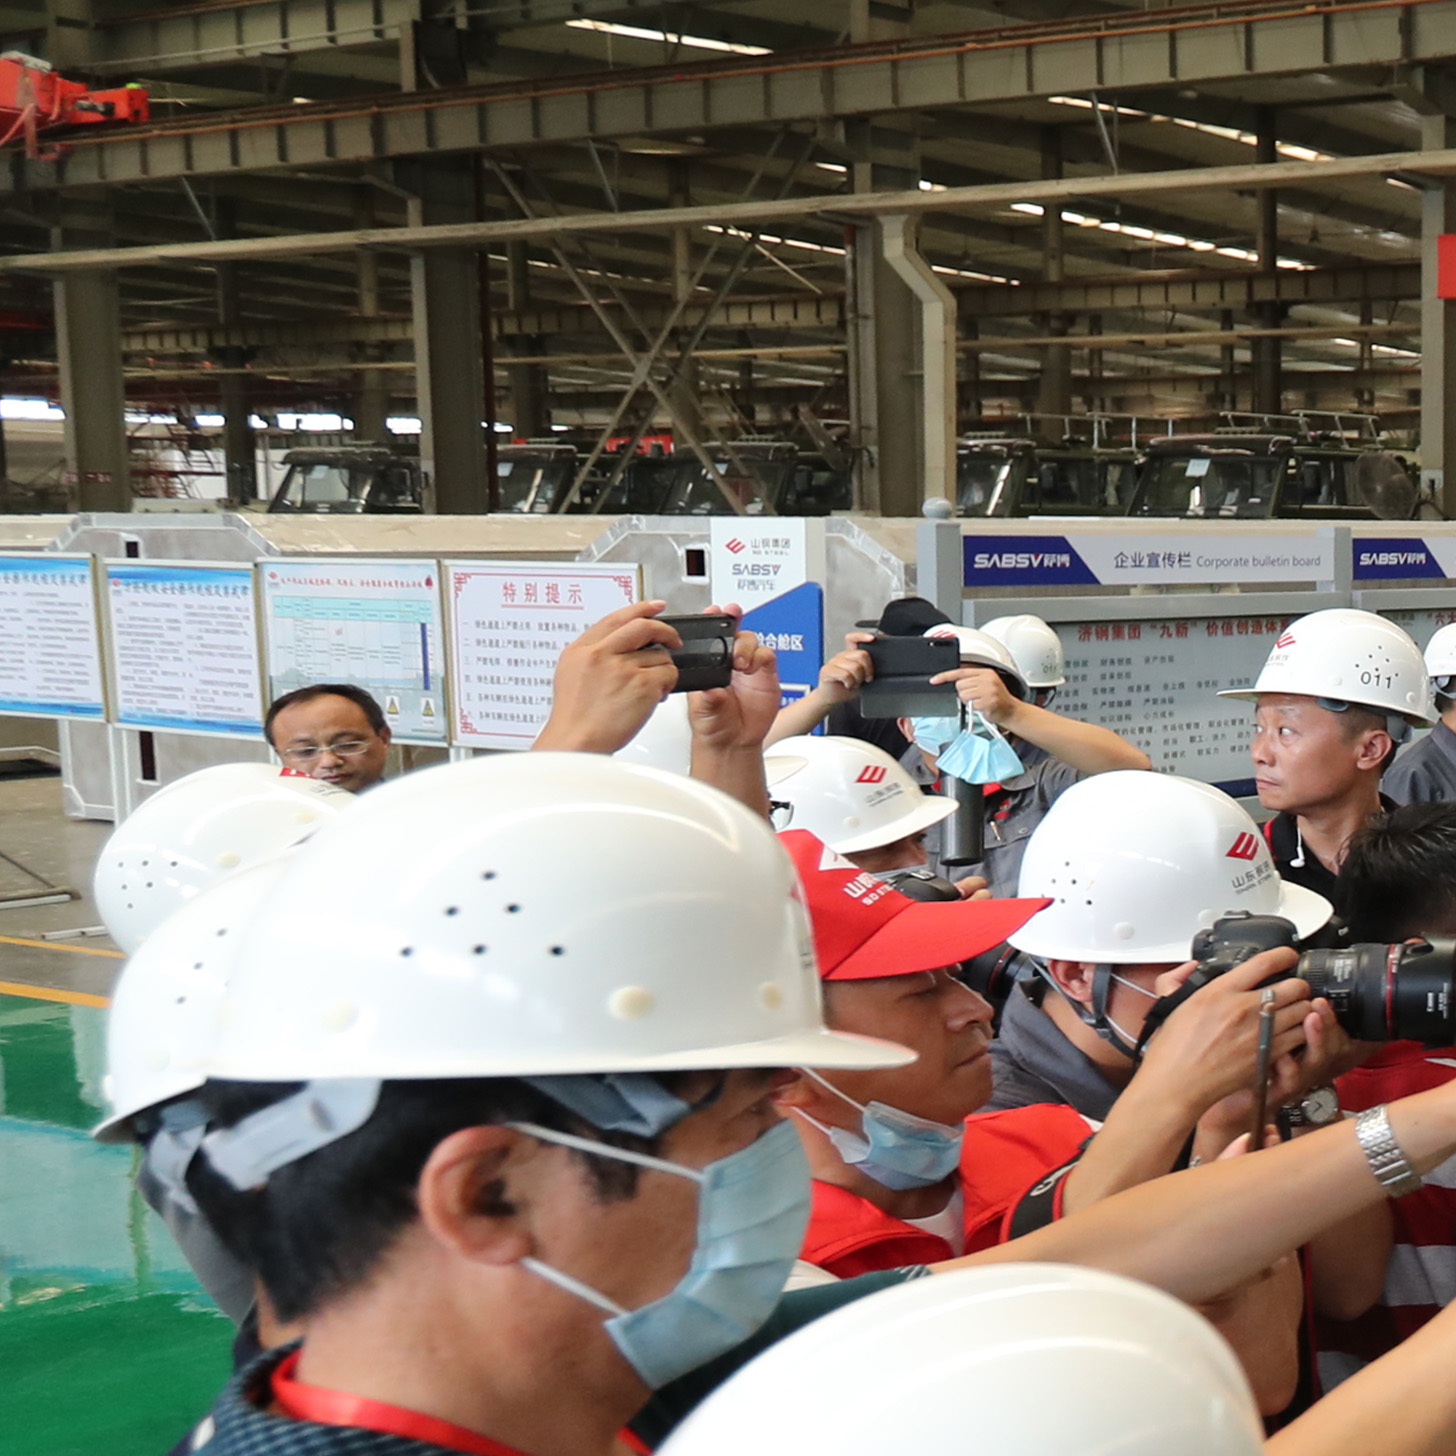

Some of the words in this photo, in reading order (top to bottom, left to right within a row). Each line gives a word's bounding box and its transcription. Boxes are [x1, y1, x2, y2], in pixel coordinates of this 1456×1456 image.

[1114, 551, 1193, 569] 企业宣传栏
[1196, 555, 1250, 569] Corporate
[1252, 555, 1290, 566] bulletin
[1292, 555, 1321, 567] board
[503, 582, 583, 604] 特别提示
[1360, 671, 1392, 689] 011
